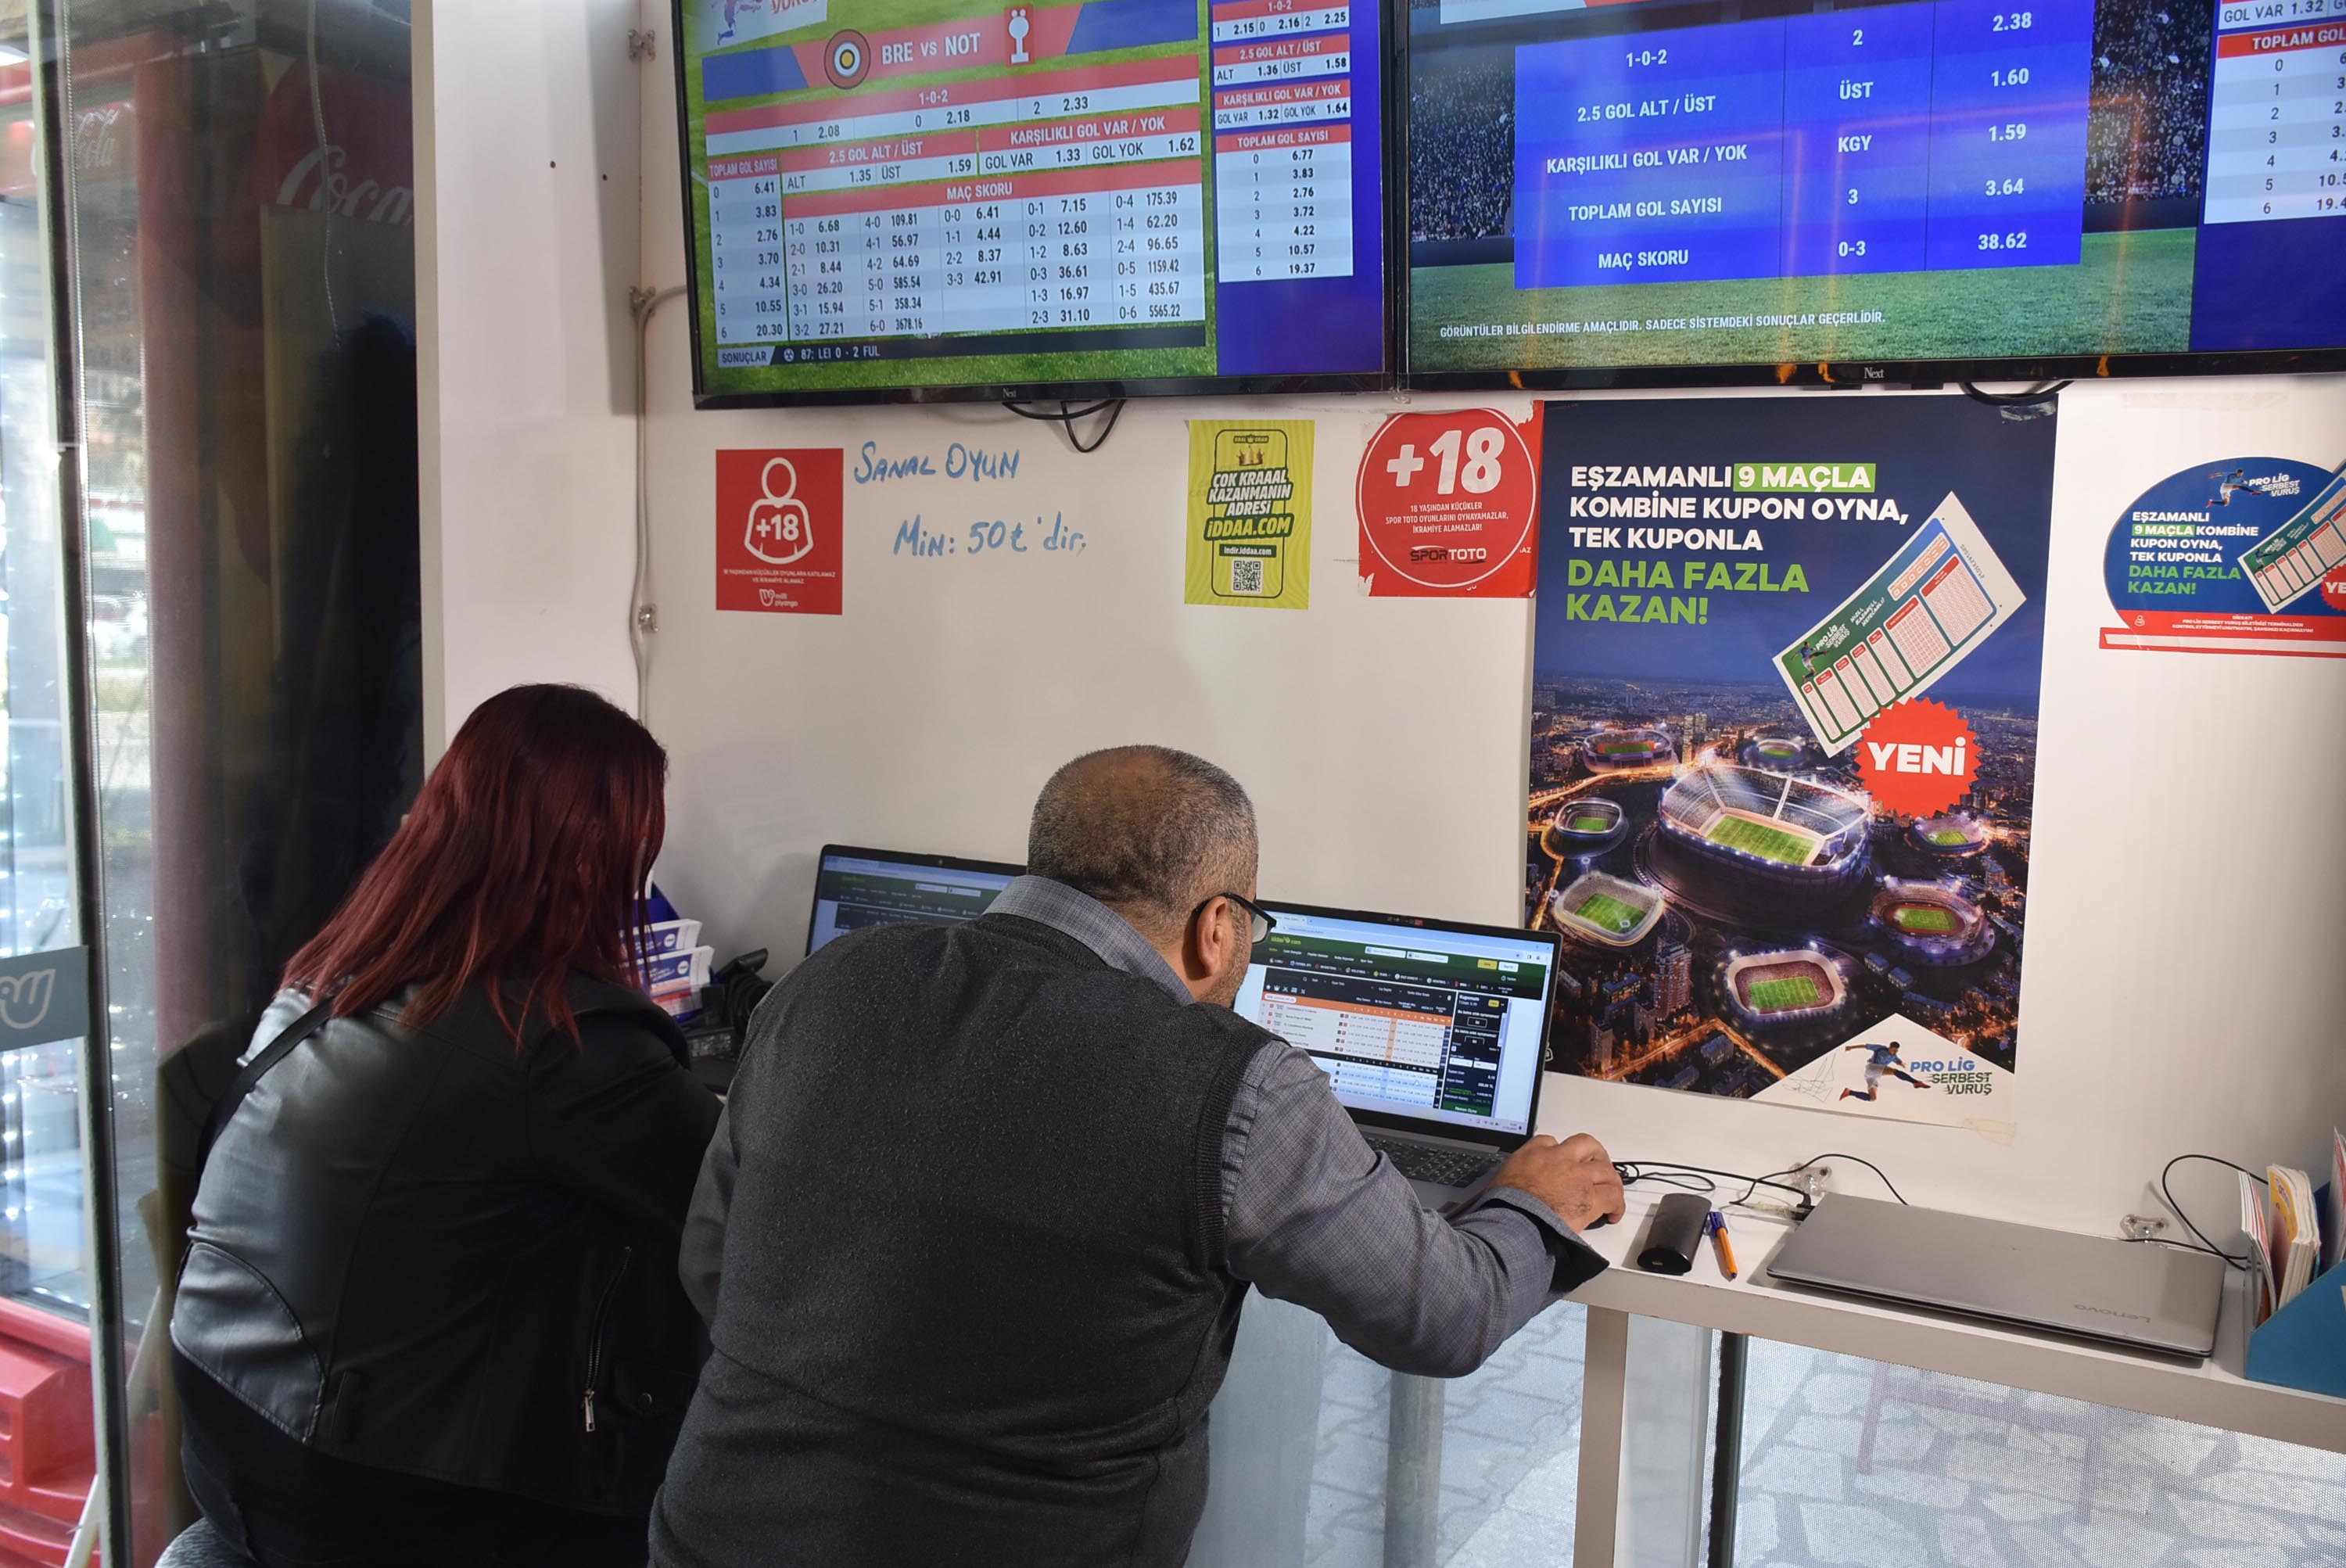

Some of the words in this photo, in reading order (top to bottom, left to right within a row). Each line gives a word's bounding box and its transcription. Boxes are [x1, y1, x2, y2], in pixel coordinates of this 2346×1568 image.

[1268, 0, 1292, 12] 1-0-2
[2224, 7, 2250, 23] GOL
[2255, 4, 2283, 19] VAR
[2291, 0, 2323, 15] 1.32
[1217, 27, 1220, 37] 1
[1233, 22, 1254, 35] 2.15
[1260, 22, 1265, 31] 0
[1279, 17, 1300, 30] 2.16
[1305, 16, 1311, 27] 2
[1324, 12, 1346, 24] 2.25
[1993, 13, 2032, 32] 2.38
[1852, 29, 1864, 46] 2
[2252, 30, 2314, 50] TOPLAM
[2317, 27, 2346, 43] GOL
[882, 41, 913, 65] BRE
[944, 33, 981, 56] NOT
[1626, 49, 1668, 67] 1-0-2
[1991, 67, 2029, 88] 1.60
[919, 90, 949, 105] 1-0-2
[1839, 80, 1874, 100] ÜST
[1577, 105, 1601, 122] 2.5
[1605, 103, 1635, 120] GOL
[1639, 99, 1669, 117] ALT
[1684, 94, 1716, 113] ÜST
[794, 131, 798, 142] 1
[818, 125, 841, 140] 2.08
[915, 115, 922, 128] 0
[946, 109, 970, 124] 2.18
[1034, 102, 1040, 115] 2
[1063, 96, 1089, 112] 2.33
[1010, 126, 1074, 146] KARŞILIKLI
[1076, 122, 1099, 139] GOL
[1103, 120, 1129, 136] VAR
[1139, 116, 1165, 133] YOK
[1988, 124, 2026, 142] 1.59
[829, 149, 845, 163] 2.5
[848, 147, 870, 162] GOL
[871, 144, 891, 160] ALT
[902, 140, 924, 156] ÜST
[1838, 135, 1872, 153] KGY
[985, 156, 1007, 170] GOL
[1010, 152, 1033, 167] VAR
[1056, 149, 1081, 163] 1.33
[1092, 145, 1117, 160] GOL
[1119, 142, 1143, 156] YOK
[1168, 137, 1196, 153] 1.62
[1546, 152, 1628, 175] KARŞILIKLI
[1632, 150, 1663, 167] GOL
[1666, 147, 1699, 164] VAR
[1714, 144, 1748, 161] YOK
[708, 161, 737, 178] TOPLAM
[739, 160, 754, 174] GOL
[755, 158, 777, 172] SAYISI
[787, 176, 805, 190] ALT
[849, 168, 872, 184] 1.35
[881, 164, 902, 180] ÜST
[948, 159, 971, 174] 1.59
[754, 181, 774, 195] 6.41
[946, 185, 972, 203] MAÇ
[975, 181, 1013, 198] SKORU
[1985, 178, 2024, 196] 3.64
[1847, 188, 1859, 205] 3
[755, 205, 777, 218] 3.83
[1028, 202, 1044, 216] 0-1
[1061, 199, 1086, 213] 7.15
[1568, 203, 1632, 222] TOPLAM
[1635, 202, 1666, 217] GOL
[1670, 197, 1722, 214] SAYISI
[757, 229, 778, 242] 2.76
[1028, 224, 1046, 238] 0-2
[1058, 220, 1087, 235] 12.60
[1838, 240, 1866, 257] 0-3
[1978, 232, 2027, 250] 38.62
[758, 253, 779, 266] 3.70
[1030, 246, 1046, 260] 1-2
[1063, 242, 1088, 257] 8.63
[1598, 253, 1633, 271] MAÇ
[1637, 249, 1688, 267] SKORU
[1030, 267, 1047, 281] 0-3
[1058, 265, 1088, 279] 36.61
[759, 276, 780, 289] 4.34
[1031, 289, 1048, 303] 1-3
[1060, 286, 1089, 300] 16.97
[755, 300, 782, 314] 10.55
[1031, 310, 1049, 324] 2-3
[1060, 309, 1090, 322] 31.10
[1440, 322, 1504, 339] GÖRÜNTÜLER
[1505, 319, 1580, 336] BİLGİLENDİRME
[1582, 318, 1642, 335] AMAÇLIDIR.
[1645, 318, 1687, 331] SADECE
[1689, 314, 1753, 329] SİSTEMDEKİ
[1756, 313, 1815, 328] SONUÇLAR
[1818, 310, 1886, 326] GEÇERLİDİR.
[756, 325, 783, 337] 20.30
[722, 350, 767, 364] SONUÇLAR
[835, 346, 841, 359] 0
[852, 346, 859, 357] 2
[863, 345, 880, 357] FUL
[1864, 367, 1885, 380] Next
[1386, 426, 1505, 495] +18
[1239, 469, 1287, 486] KRAAAL
[1571, 466, 1732, 492] EŞZAMANLI
[1738, 466, 1756, 488] 9
[1762, 466, 1871, 493] MAÇLA
[2248, 476, 2271, 486] PRO
[2272, 472, 2290, 483] LİG
[2261, 479, 2300, 491] SERBEST
[1208, 484, 1292, 503] KAZANMANIN
[2270, 487, 2300, 497] VURUŞ
[1410, 504, 1418, 513] 18
[1419, 504, 1449, 513] YAŞINDAN
[1451, 501, 1483, 511] KÜÇÜKLER
[1569, 490, 1696, 518] KOMBİNE
[1702, 498, 1804, 520] KUPON
[1811, 498, 1909, 525] OYNA,
[1385, 516, 1402, 525] SPOR
[1403, 515, 1418, 524] TOTO
[1419, 514, 1456, 523] OYUNLARINI
[2132, 511, 2210, 523] EŞZAMANLI
[756, 513, 799, 541] +18
[1412, 525, 1442, 534] İKRAMİYE
[1443, 523, 1483, 533] ALAMAZLAR!
[2134, 526, 2143, 535] 9
[2145, 526, 2194, 537] MAÇLA
[2195, 523, 2258, 536] KOMBİNE
[1569, 527, 1621, 548] TEK
[1627, 528, 1763, 551] KUPONLA
[2131, 538, 2179, 549] KUPON
[2181, 539, 2222, 551] OYNA,
[2130, 552, 2155, 562] TEK
[2158, 552, 2222, 563] KUPONLA
[1567, 559, 1674, 589] DAHA
[1684, 562, 1810, 592] FAZLA
[2129, 565, 2179, 578] DAHA
[2183, 566, 2241, 579] FAZLA
[2128, 581, 2197, 594] KAZAN!
[2325, 581, 2346, 594] YE
[1566, 594, 1709, 625] KAZAN!
[1867, 736, 1966, 776] YENİ
[1910, 1060, 1945, 1072] PRO
[1948, 1056, 1975, 1071] LİG
[1931, 1071, 1993, 1084] SERBEST
[1946, 1083, 1993, 1095] VURUŞ
